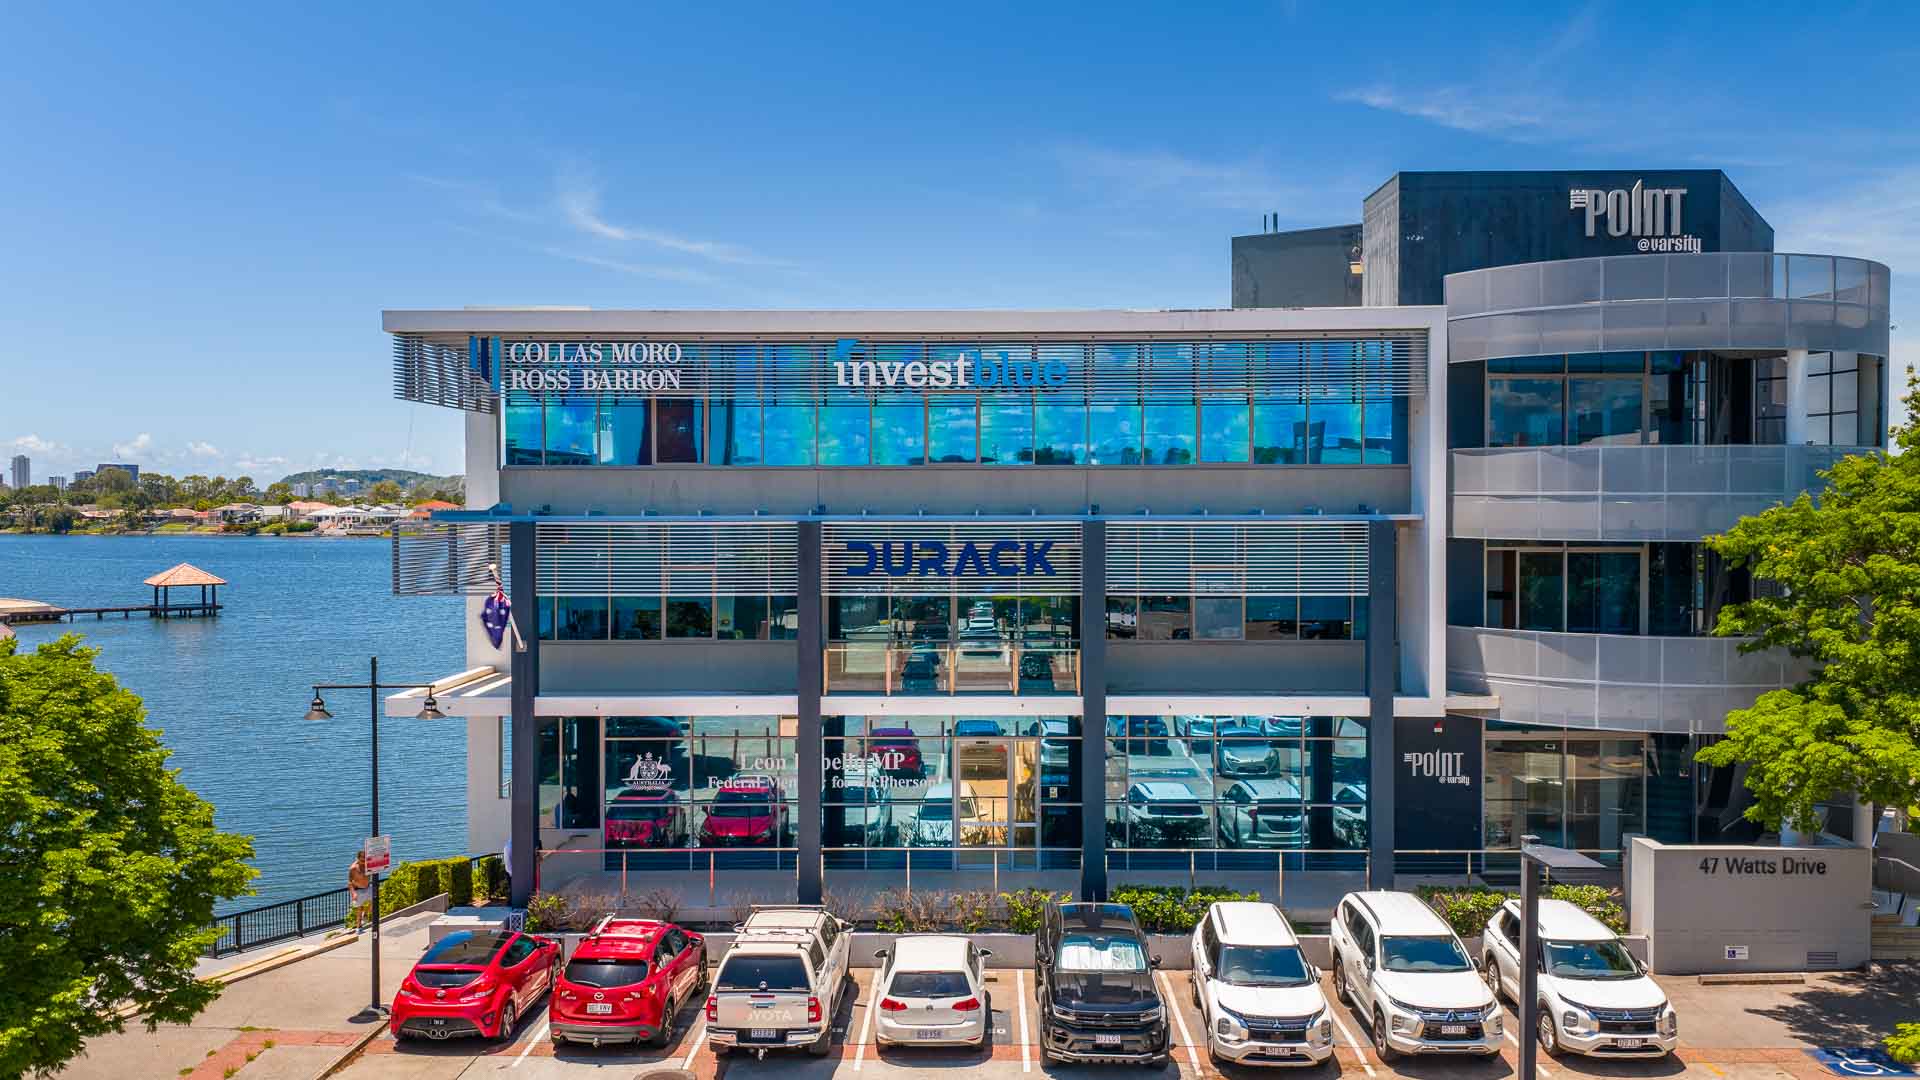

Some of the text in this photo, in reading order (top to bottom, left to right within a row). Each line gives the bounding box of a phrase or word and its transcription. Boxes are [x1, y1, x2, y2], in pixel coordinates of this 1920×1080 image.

[1585, 178, 1688, 237] POINT
[1637, 235, 1702, 253] @varsity
[510, 343, 682, 363] COLLAS MORO
[510, 370, 682, 391] ROSS BARRON
[847, 540, 1057, 576] DURACK
[740, 753, 786, 770] Leon
[871, 752, 905, 770] MP
[1412, 749, 1465, 777] POINT
[708, 776, 761, 789] Federal
[1699, 857, 1827, 875] 47 Watts Drive
[742, 1009, 793, 1021] YOTA
